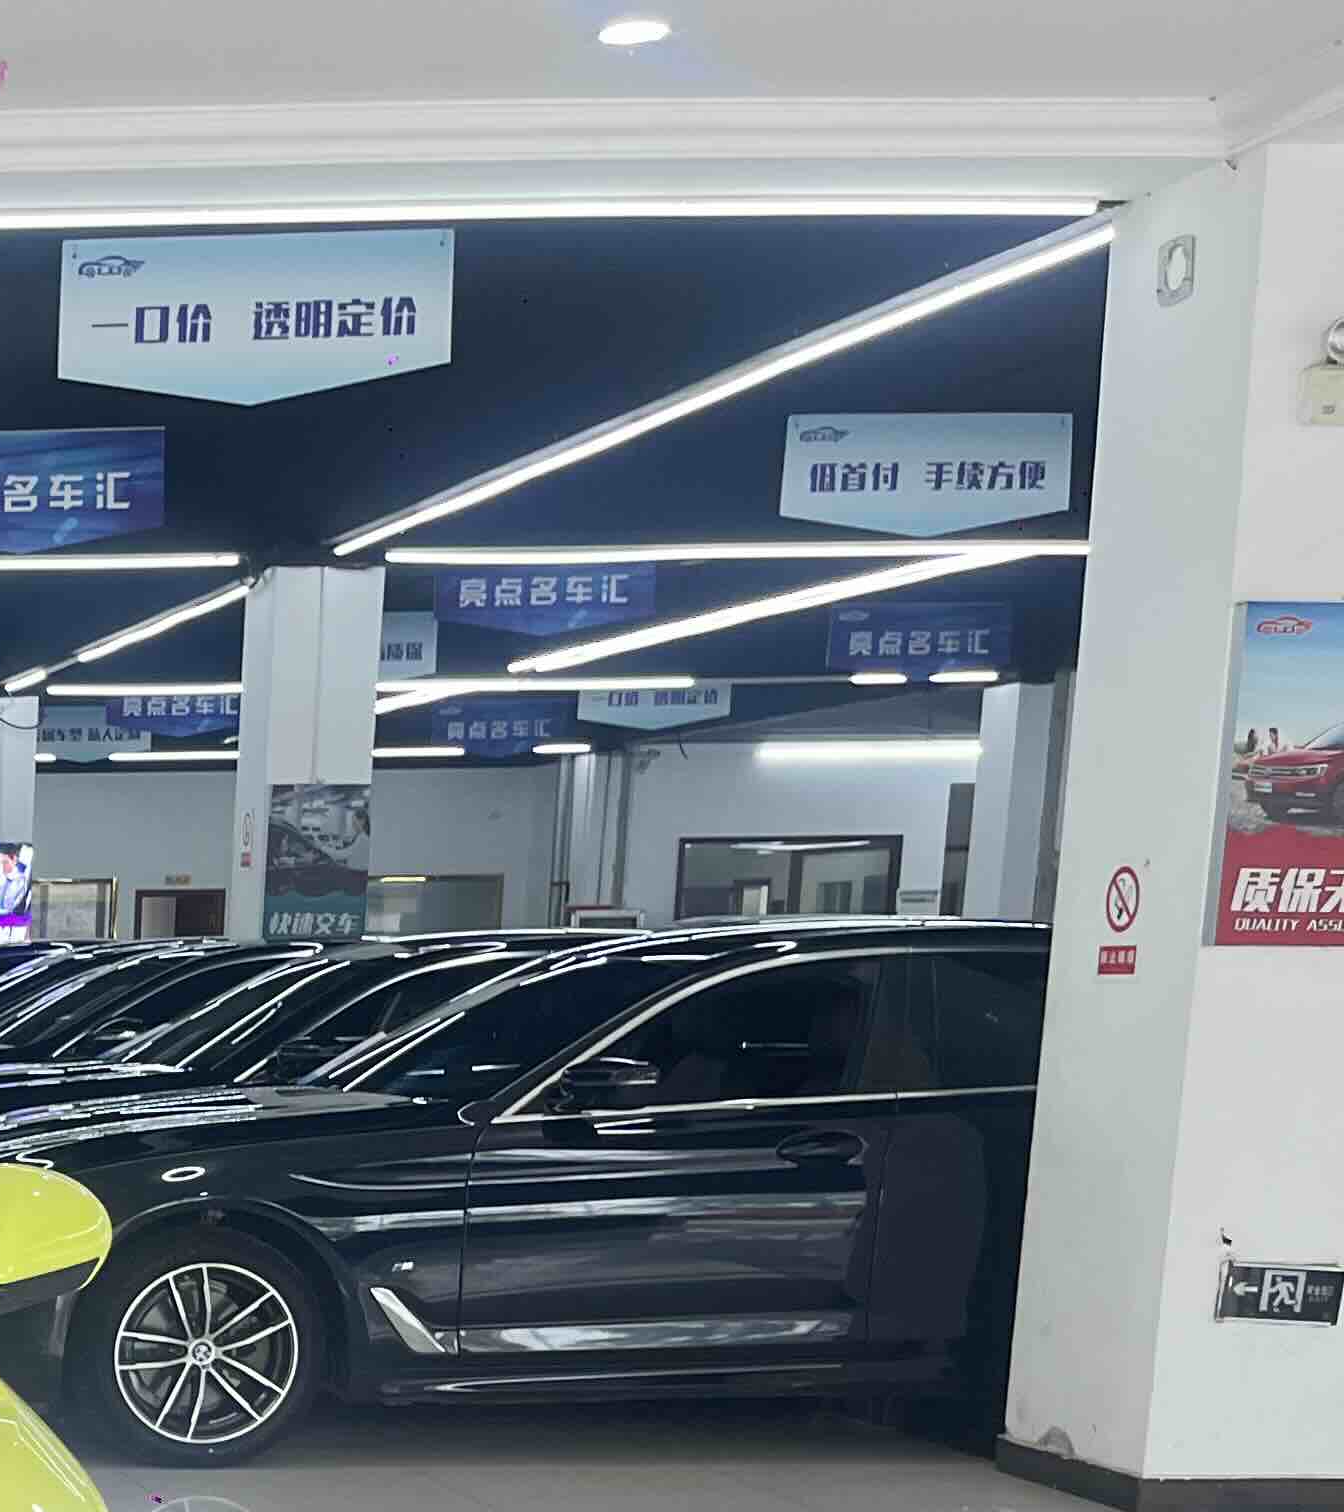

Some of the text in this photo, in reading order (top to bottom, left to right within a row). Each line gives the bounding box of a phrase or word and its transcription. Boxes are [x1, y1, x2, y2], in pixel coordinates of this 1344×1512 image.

[91, 296, 416, 344] 一口价 透明定价
[809, 461, 1046, 492] 低首付 手续方便
[459, 574, 630, 608] 亮点名车汇
[381, 642, 423, 661] 质保
[849, 629, 990, 656] 亮点名车汇
[1233, 918, 1300, 932] QUALITY
